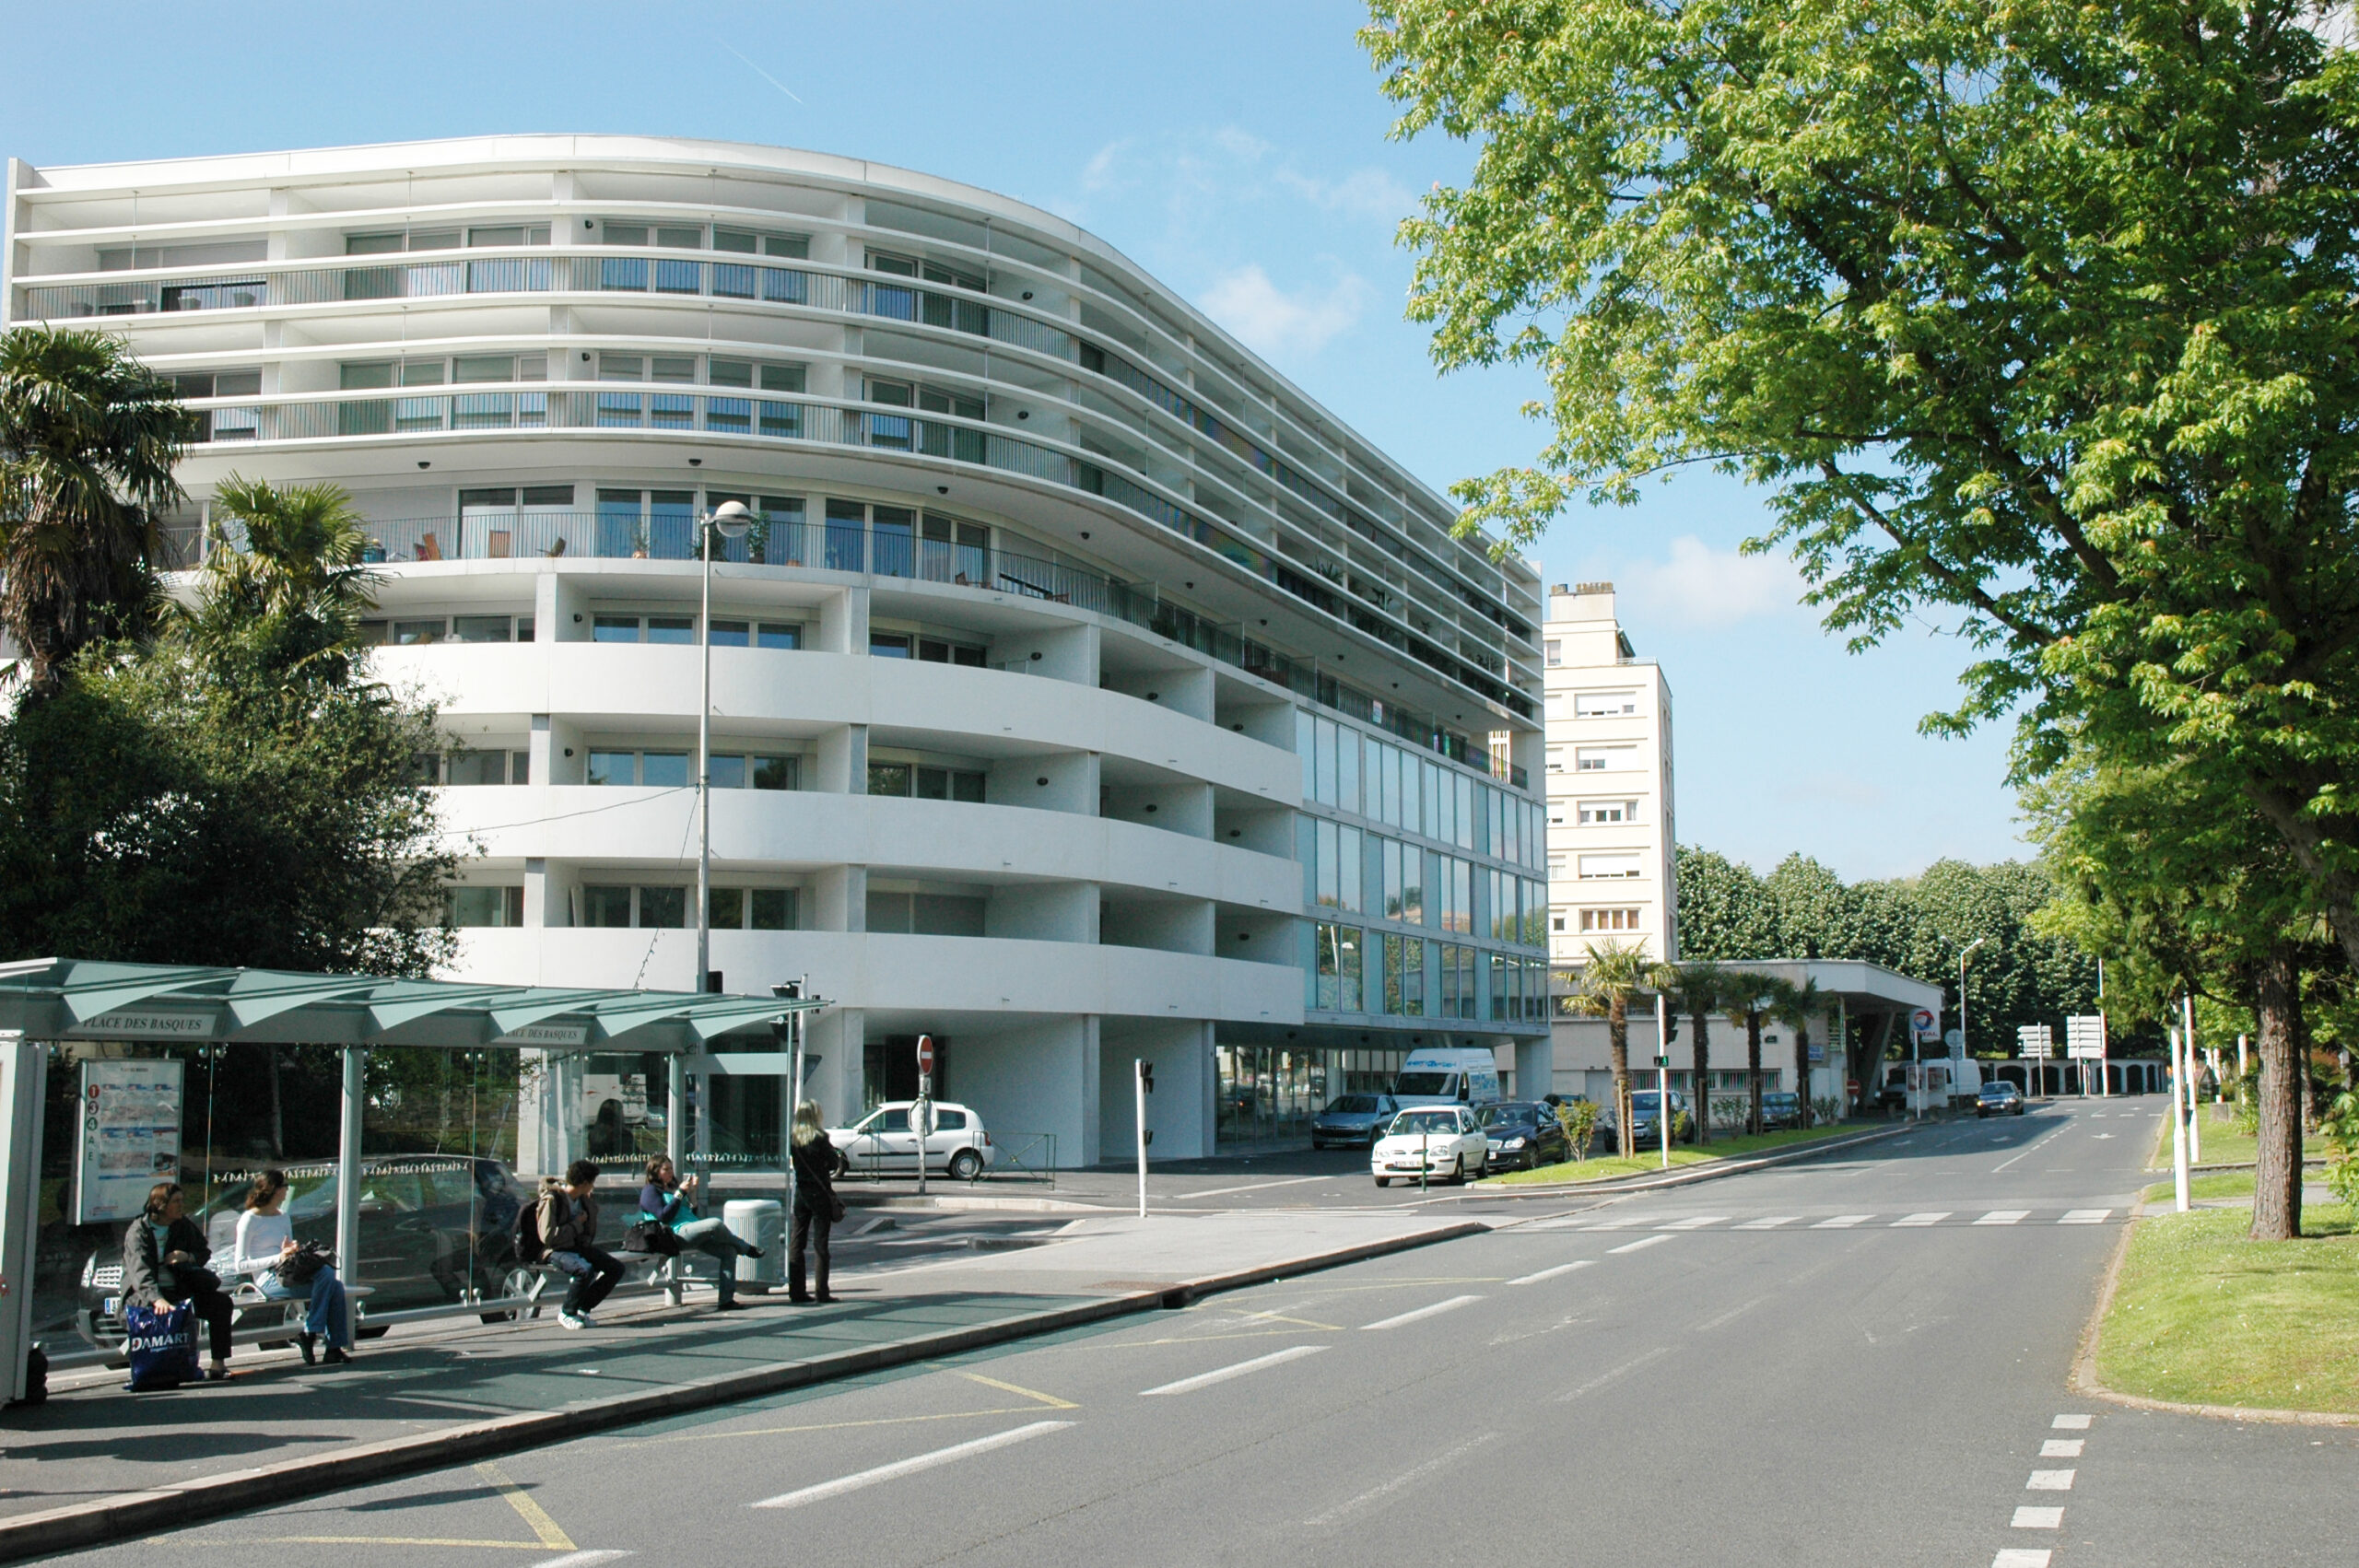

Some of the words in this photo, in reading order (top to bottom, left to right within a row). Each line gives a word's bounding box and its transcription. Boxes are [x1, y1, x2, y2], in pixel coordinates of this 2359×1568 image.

[84, 1017, 122, 1029] PLACE
[124, 1018, 147, 1029] DES
[150, 1018, 202, 1032] BASQUES
[528, 1029, 542, 1038] DES
[544, 1030, 577, 1040] BASQUES
[88, 1136, 94, 1144] A
[88, 1152, 93, 1161] E
[132, 1333, 189, 1352] DAMART
